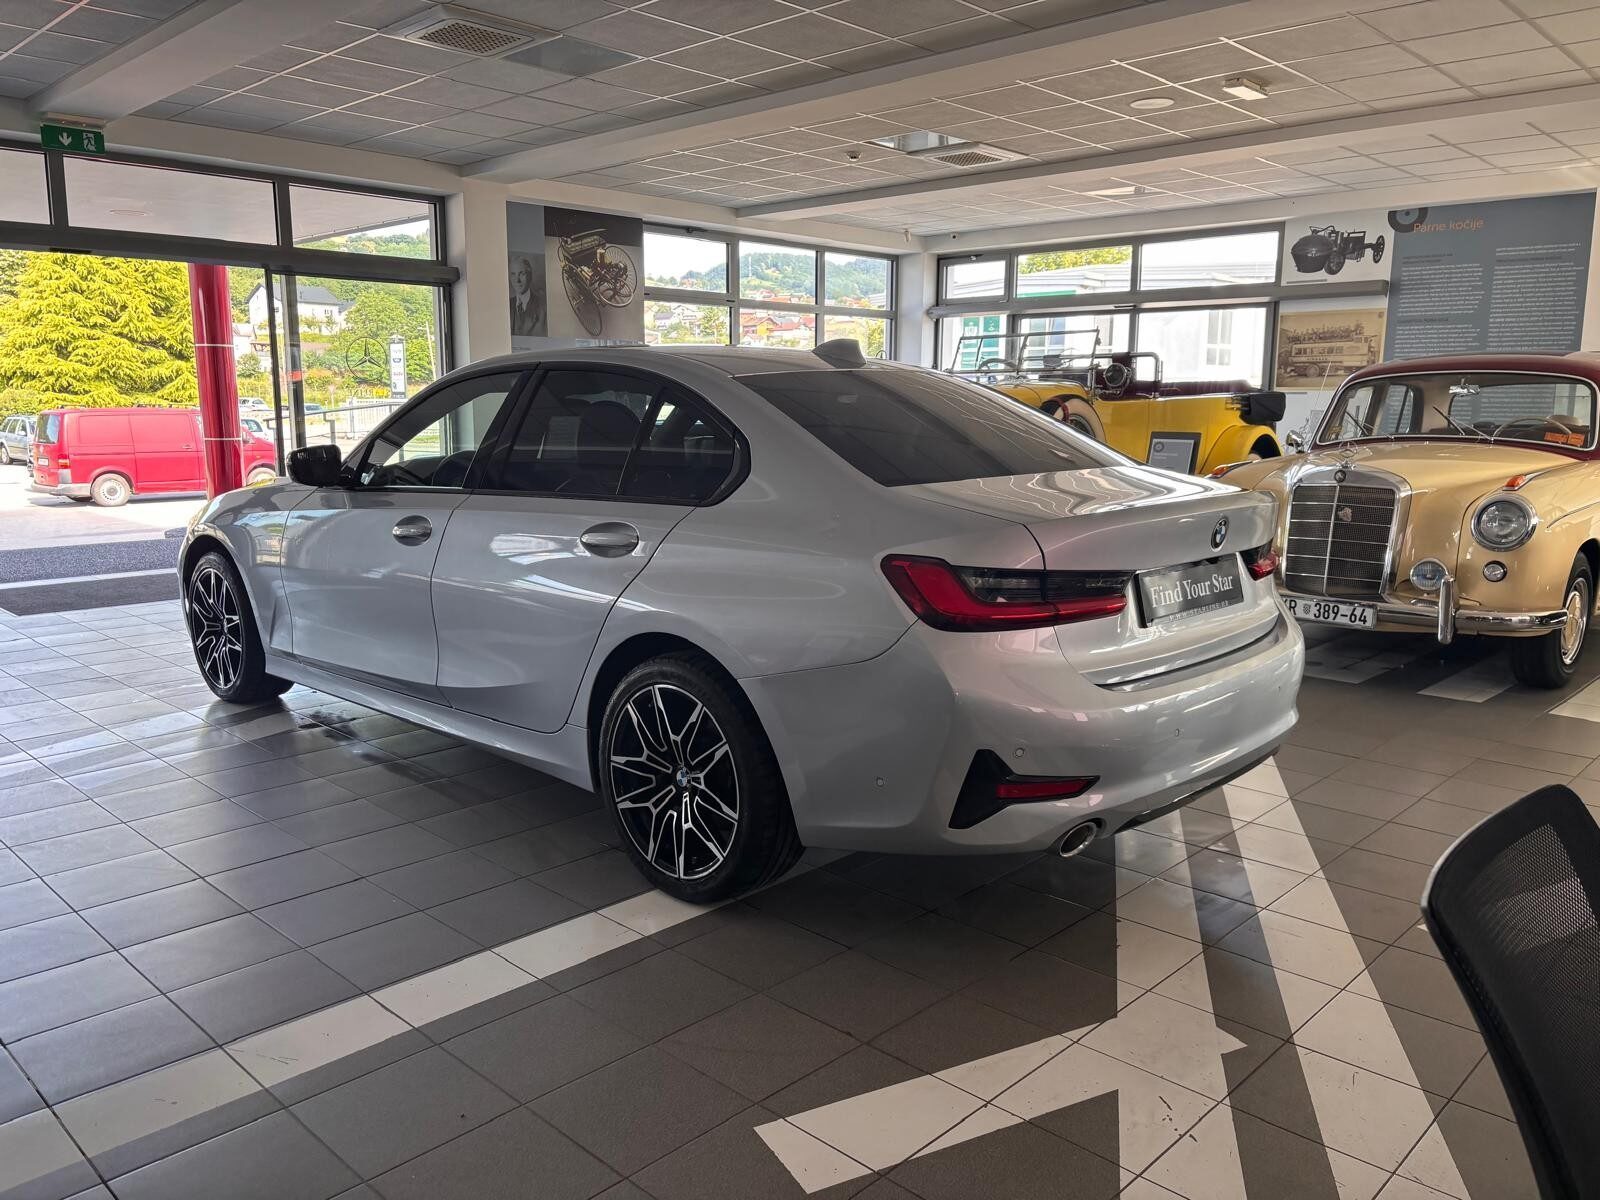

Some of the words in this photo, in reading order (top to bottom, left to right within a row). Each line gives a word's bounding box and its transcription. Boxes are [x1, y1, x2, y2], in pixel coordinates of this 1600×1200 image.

[1413, 222, 1447, 233] Parne
[1150, 580, 1183, 608] Find
[1182, 579, 1211, 600] Your
[1211, 573, 1233, 593] Star
[1313, 602, 1368, 625] 389-64
